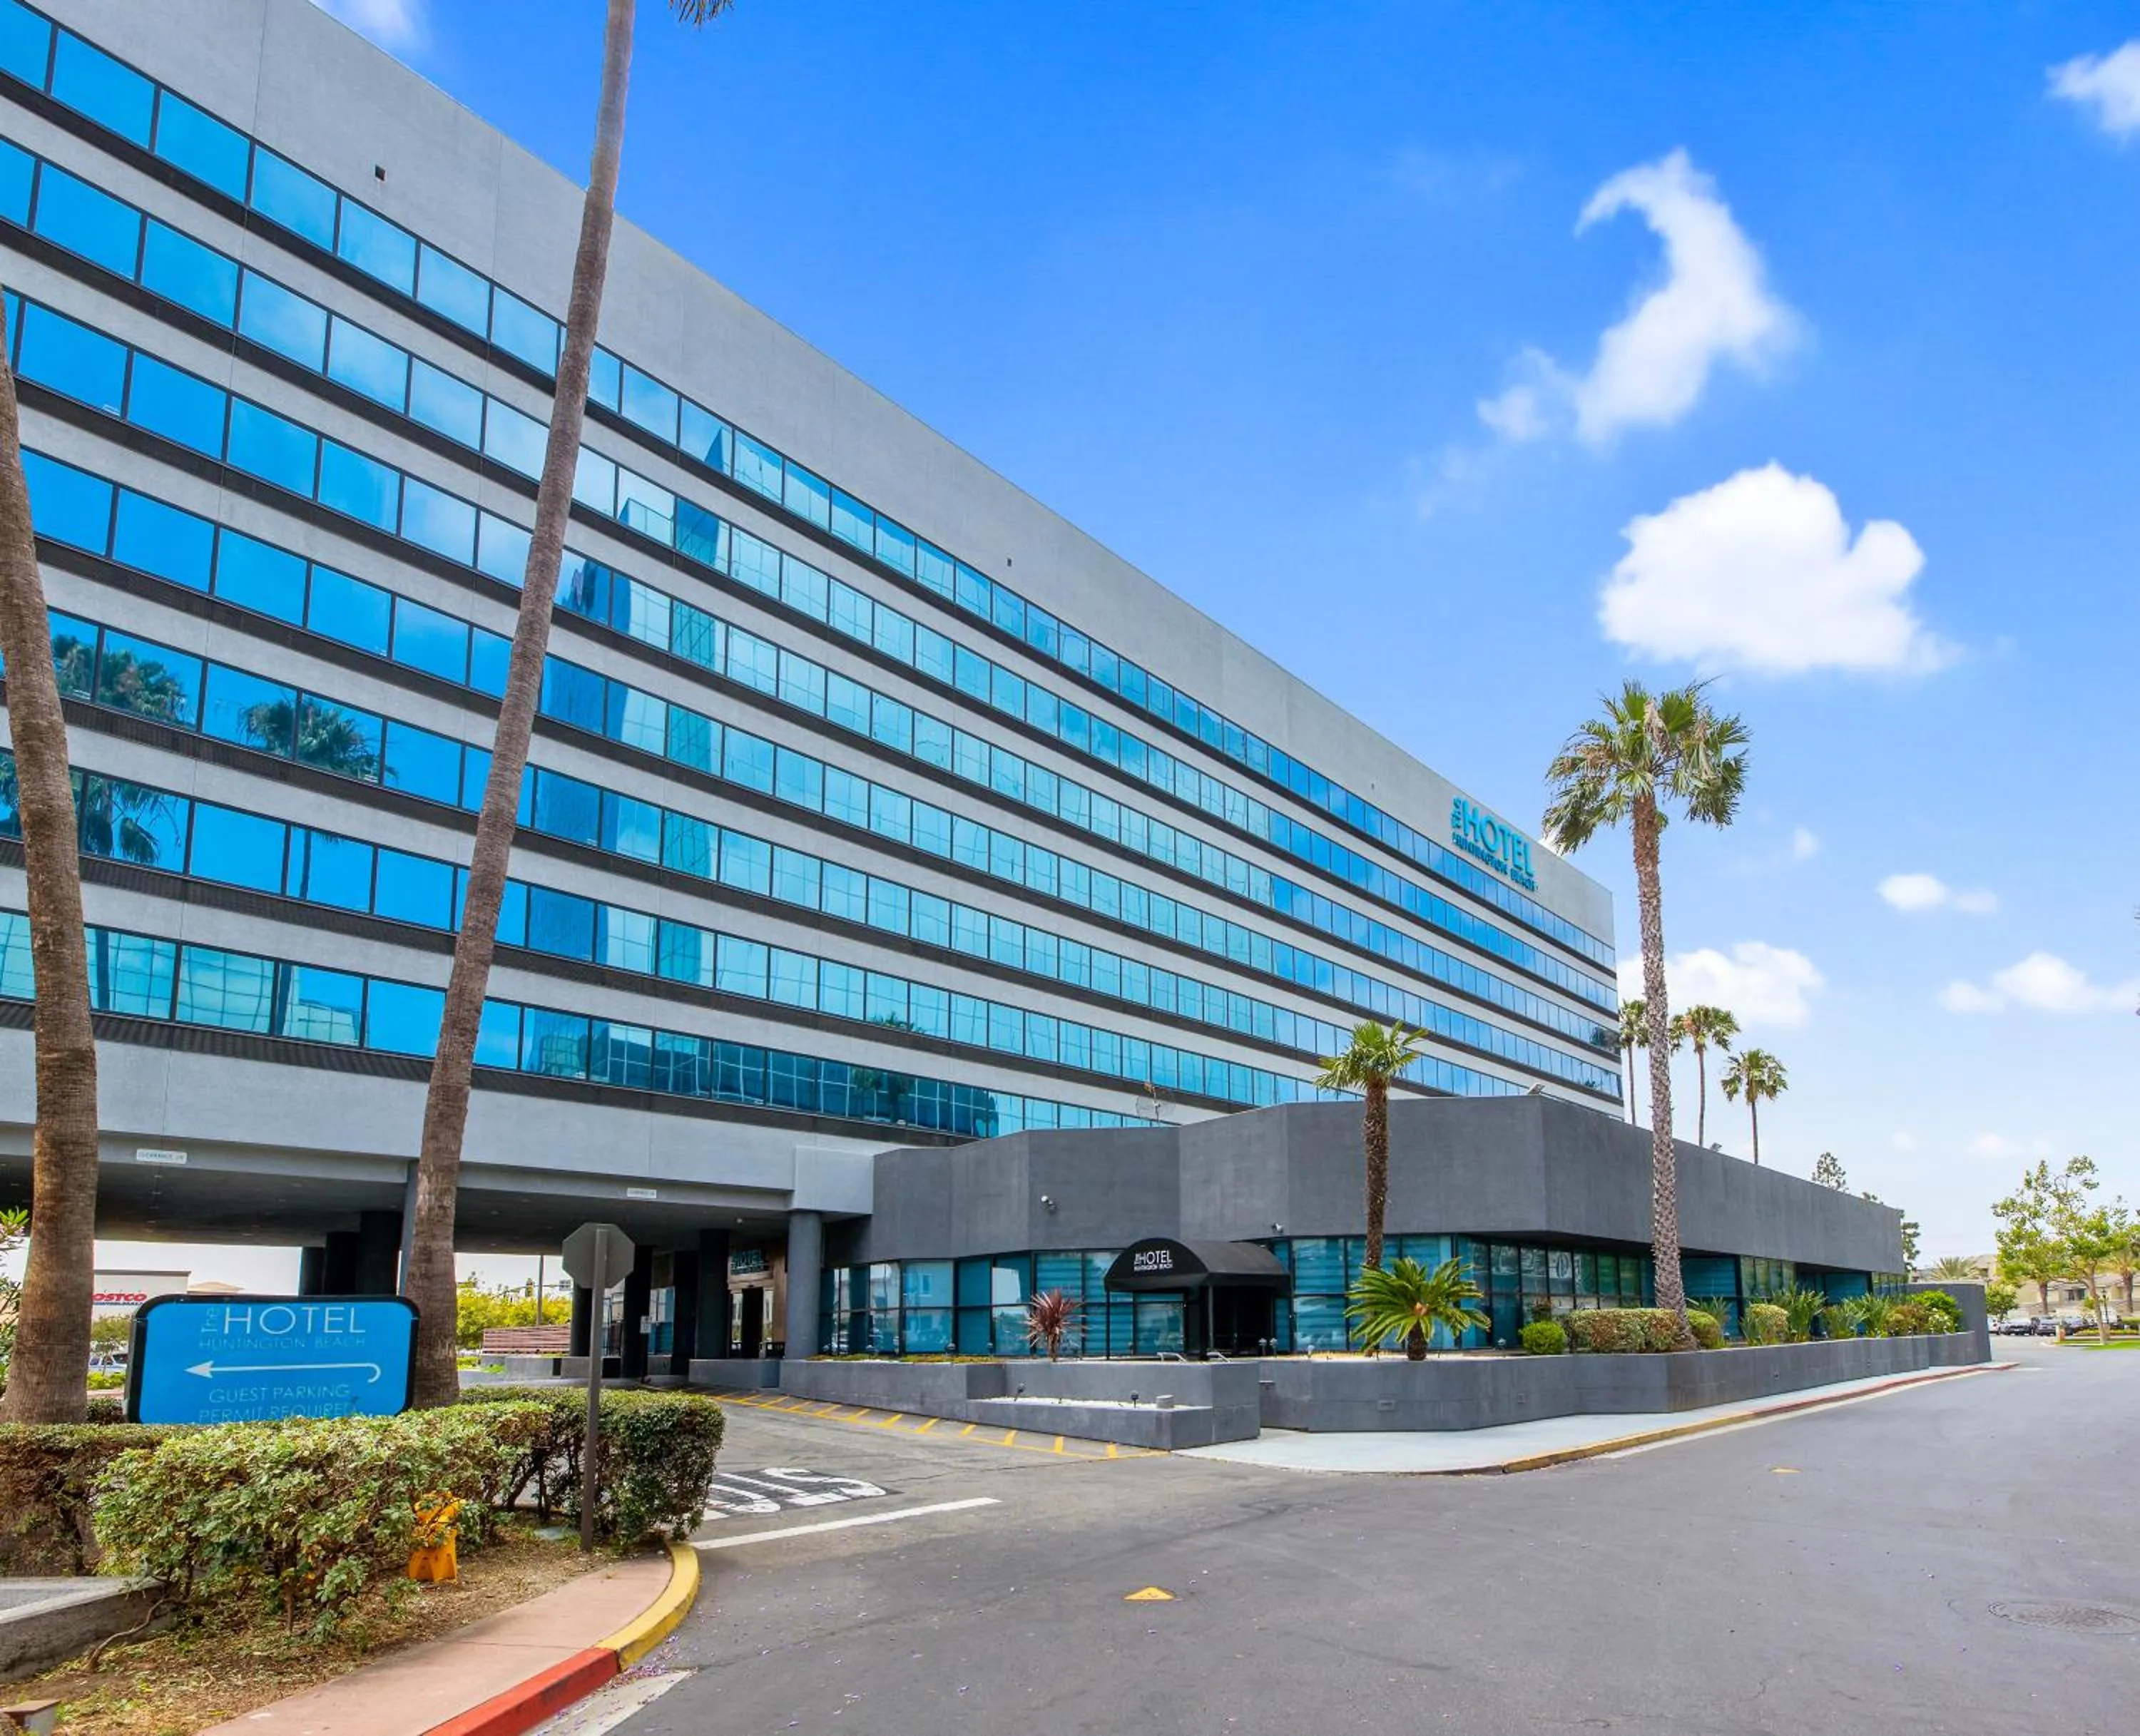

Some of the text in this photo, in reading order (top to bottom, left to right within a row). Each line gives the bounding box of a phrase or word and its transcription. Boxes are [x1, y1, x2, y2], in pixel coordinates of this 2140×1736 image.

[1462, 800, 1534, 877] HOTEL
[1139, 1250, 1172, 1265] HOTEL
[91, 1293, 147, 1302] OSTCO
[223, 1306, 366, 1334] HOTEL
[199, 1336, 365, 1350] HUNTINGTON BEACH
[209, 1384, 350, 1403] GUEST PARKING
[703, 1467, 887, 1521] STO
